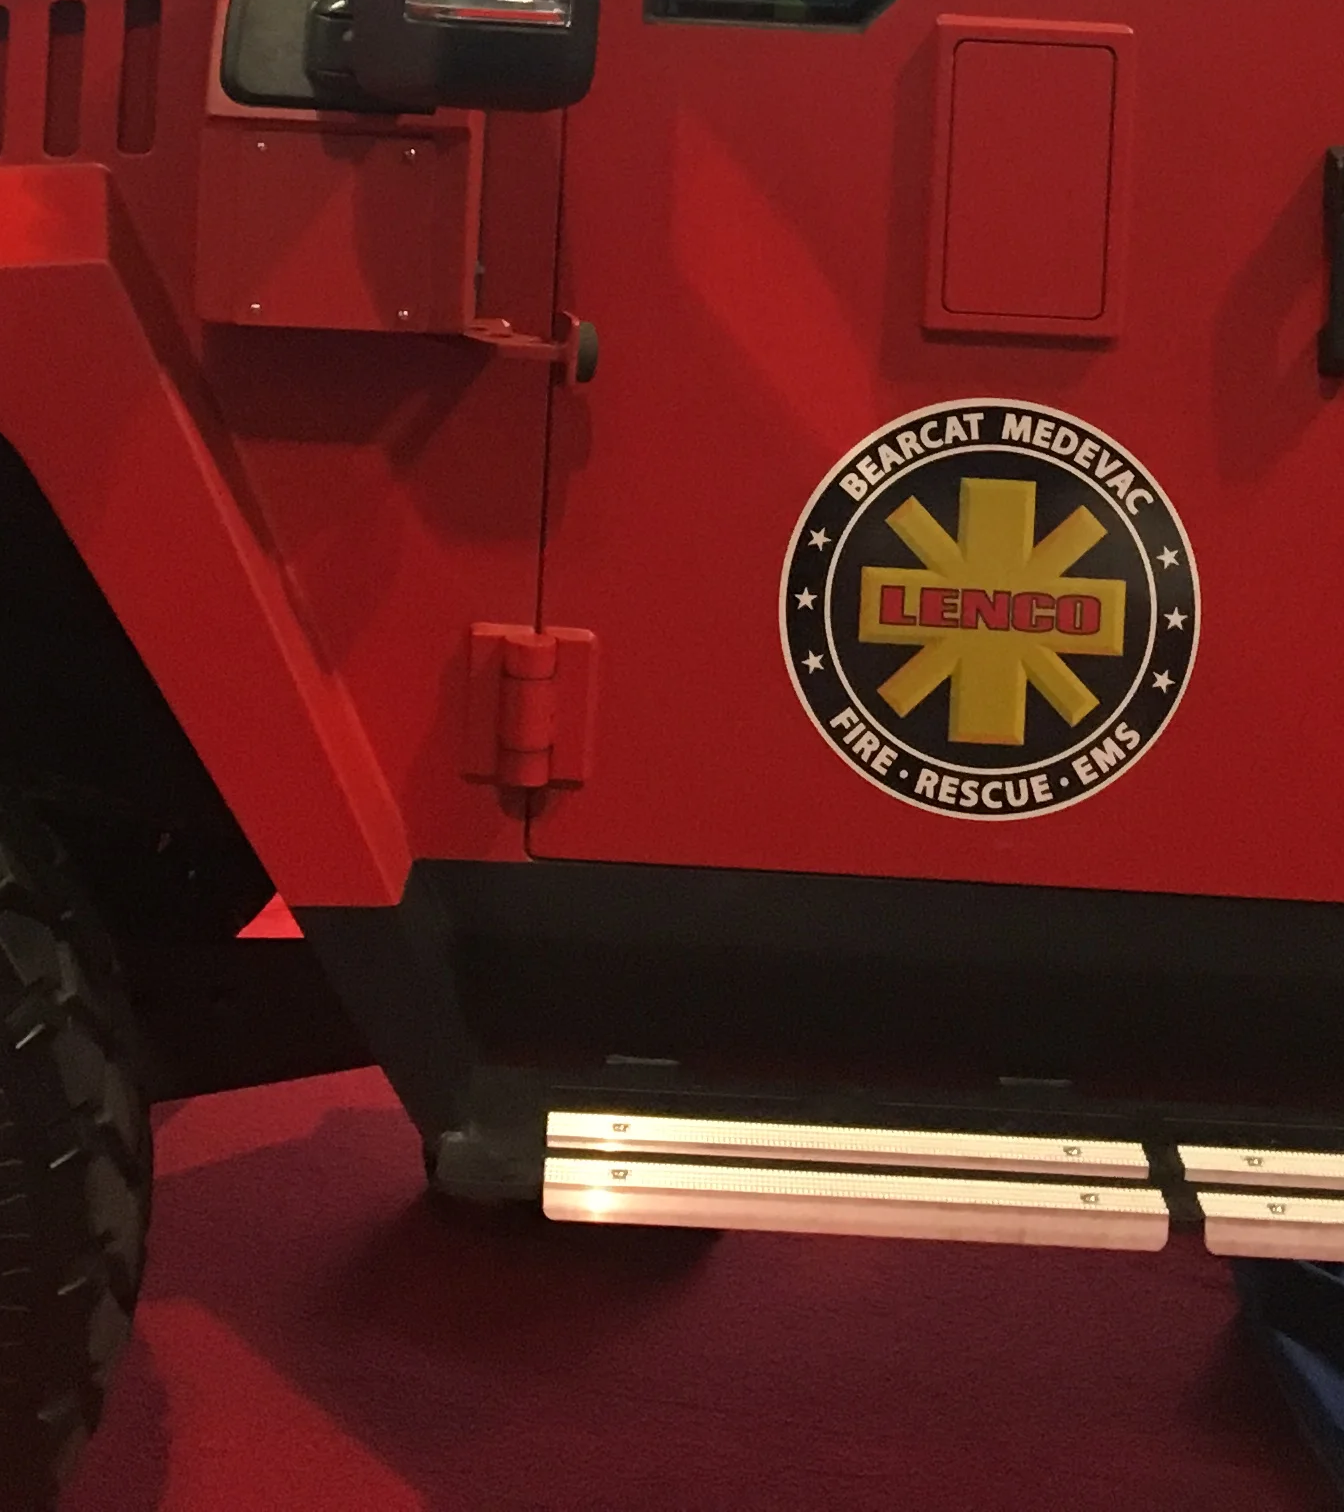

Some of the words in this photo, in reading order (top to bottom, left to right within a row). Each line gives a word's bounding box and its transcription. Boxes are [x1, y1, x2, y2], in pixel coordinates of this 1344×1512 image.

[838, 413, 985, 502] BEARCAT
[1001, 413, 1155, 516] MEDEVAC
[879, 585, 1102, 636] LENCO
[829, 706, 899, 777] FIRE
[914, 768, 1054, 809] RESCUE
[1072, 721, 1142, 787] EMS
